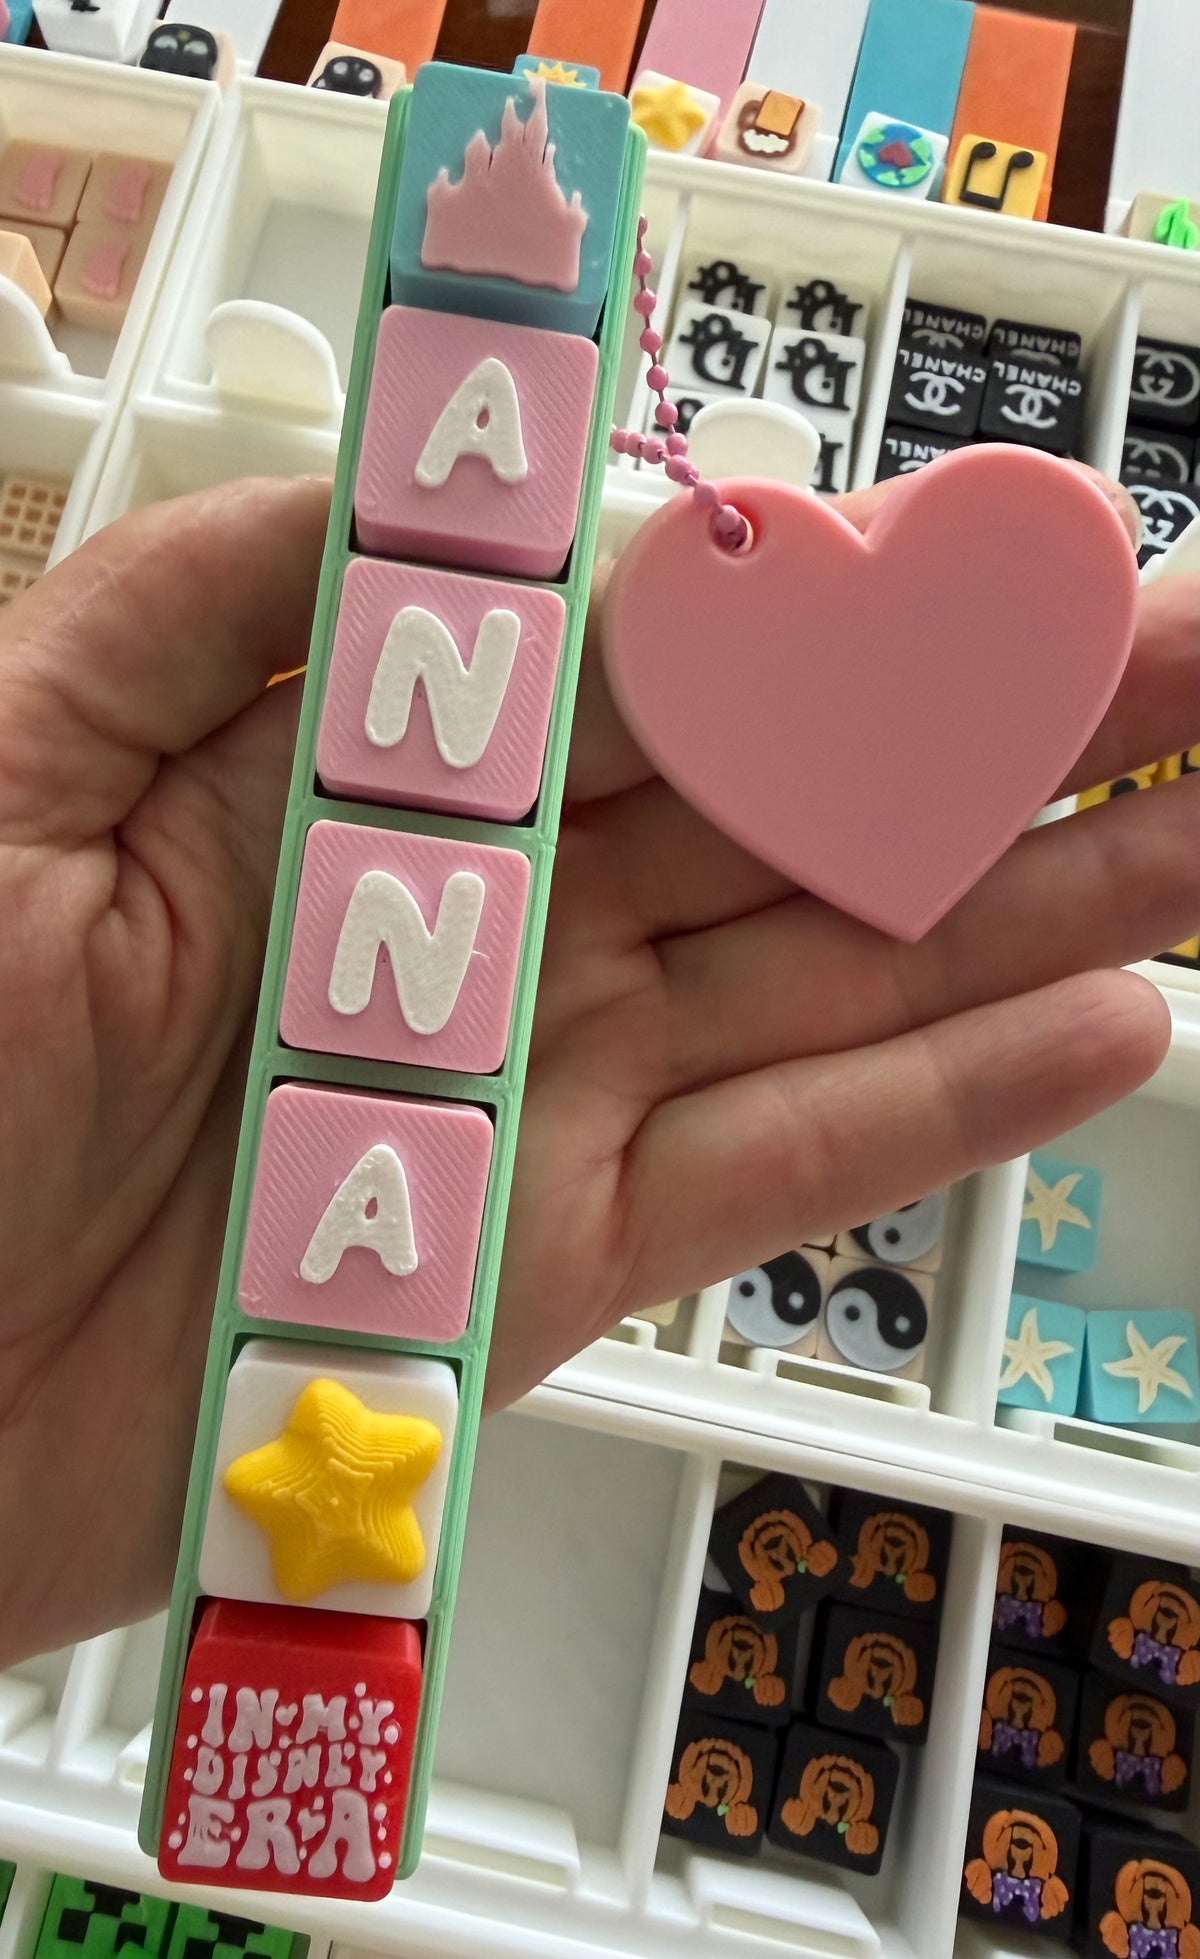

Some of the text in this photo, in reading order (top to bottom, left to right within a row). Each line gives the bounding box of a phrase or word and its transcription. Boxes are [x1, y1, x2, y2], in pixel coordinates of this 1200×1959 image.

[904, 308, 984, 341] CHANEL
[994, 327, 1080, 358] CHANEL
[900, 349, 988, 384] CHANEL
[993, 361, 1083, 397] CHANEL
[201, 1683, 395, 1753] IN MY
[177, 1788, 377, 1883] ERA
